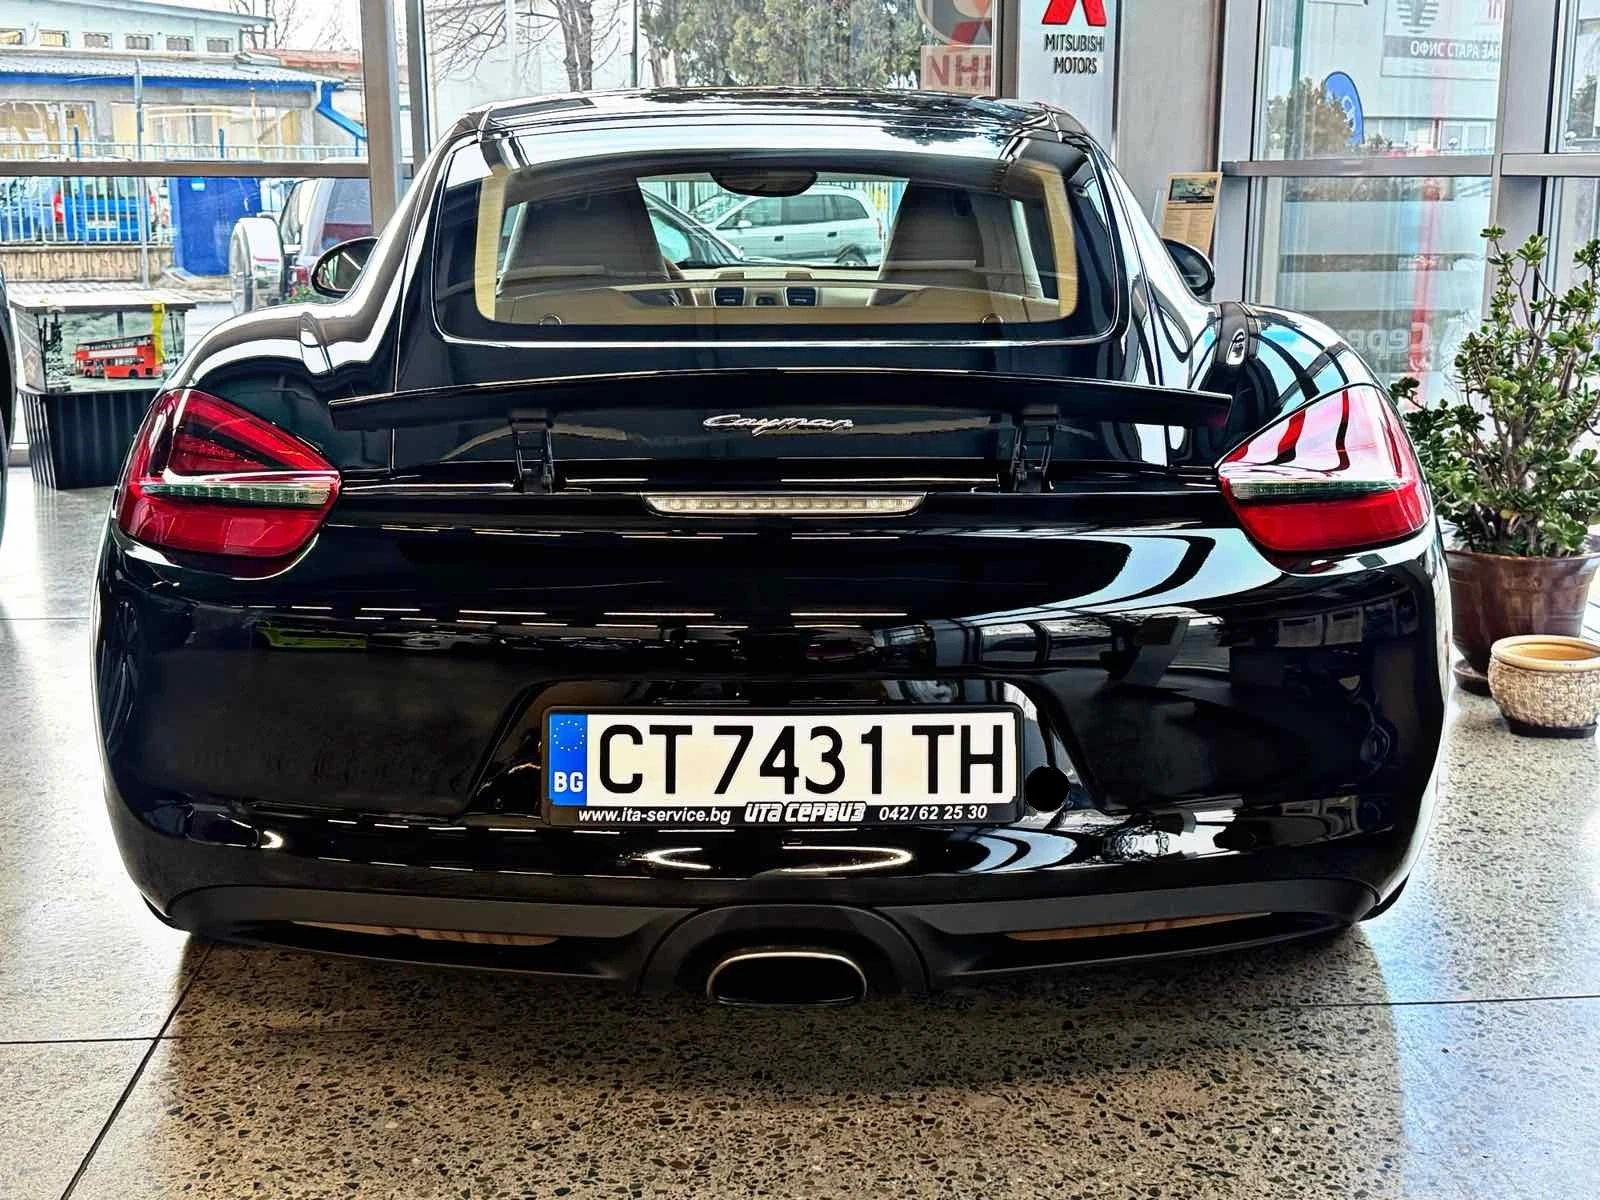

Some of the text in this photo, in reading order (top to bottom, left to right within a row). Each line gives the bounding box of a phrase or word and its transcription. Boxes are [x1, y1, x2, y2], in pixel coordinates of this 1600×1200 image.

[1044, 34, 1105, 52] MITSUBISHI
[1410, 40, 1446, 57] ОФИС
[1054, 57, 1097, 74] MOTORS
[702, 414, 854, 437] Cayman
[600, 724, 1004, 794] CT 7431 TH
[553, 771, 584, 793] BG
[578, 807, 732, 825] www.ita-service.bg
[943, 805, 963, 820] 25
[967, 804, 988, 819] 30
